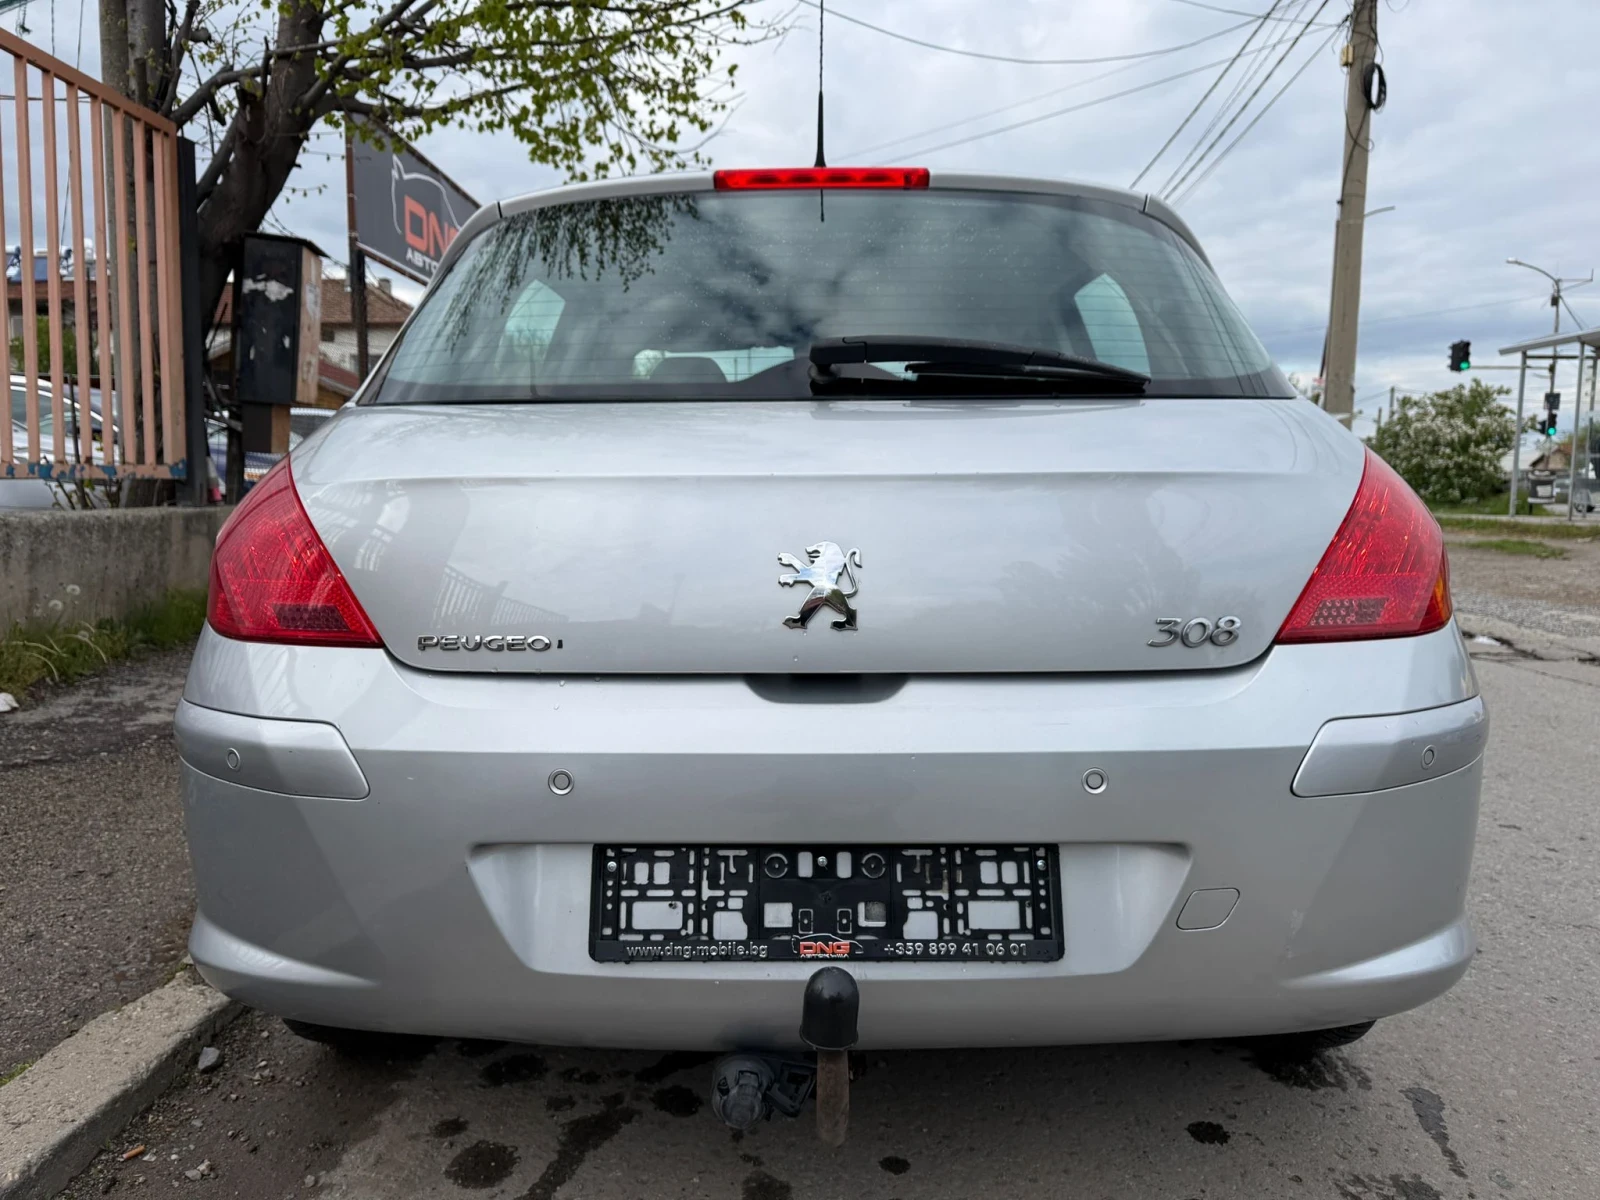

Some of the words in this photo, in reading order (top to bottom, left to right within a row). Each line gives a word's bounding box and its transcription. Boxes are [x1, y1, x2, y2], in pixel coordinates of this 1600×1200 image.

[404, 194, 459, 257] DN
[405, 247, 439, 275] АВТО
[1147, 615, 1242, 648] 308
[626, 942, 768, 958] www.dng.mobile.bg
[799, 941, 850, 955] DNG
[884, 942, 924, 956] +359
[928, 942, 957, 956] 899
[961, 943, 980, 956] 41
[985, 943, 1005, 956] 06
[1009, 943, 1028, 956] 01
